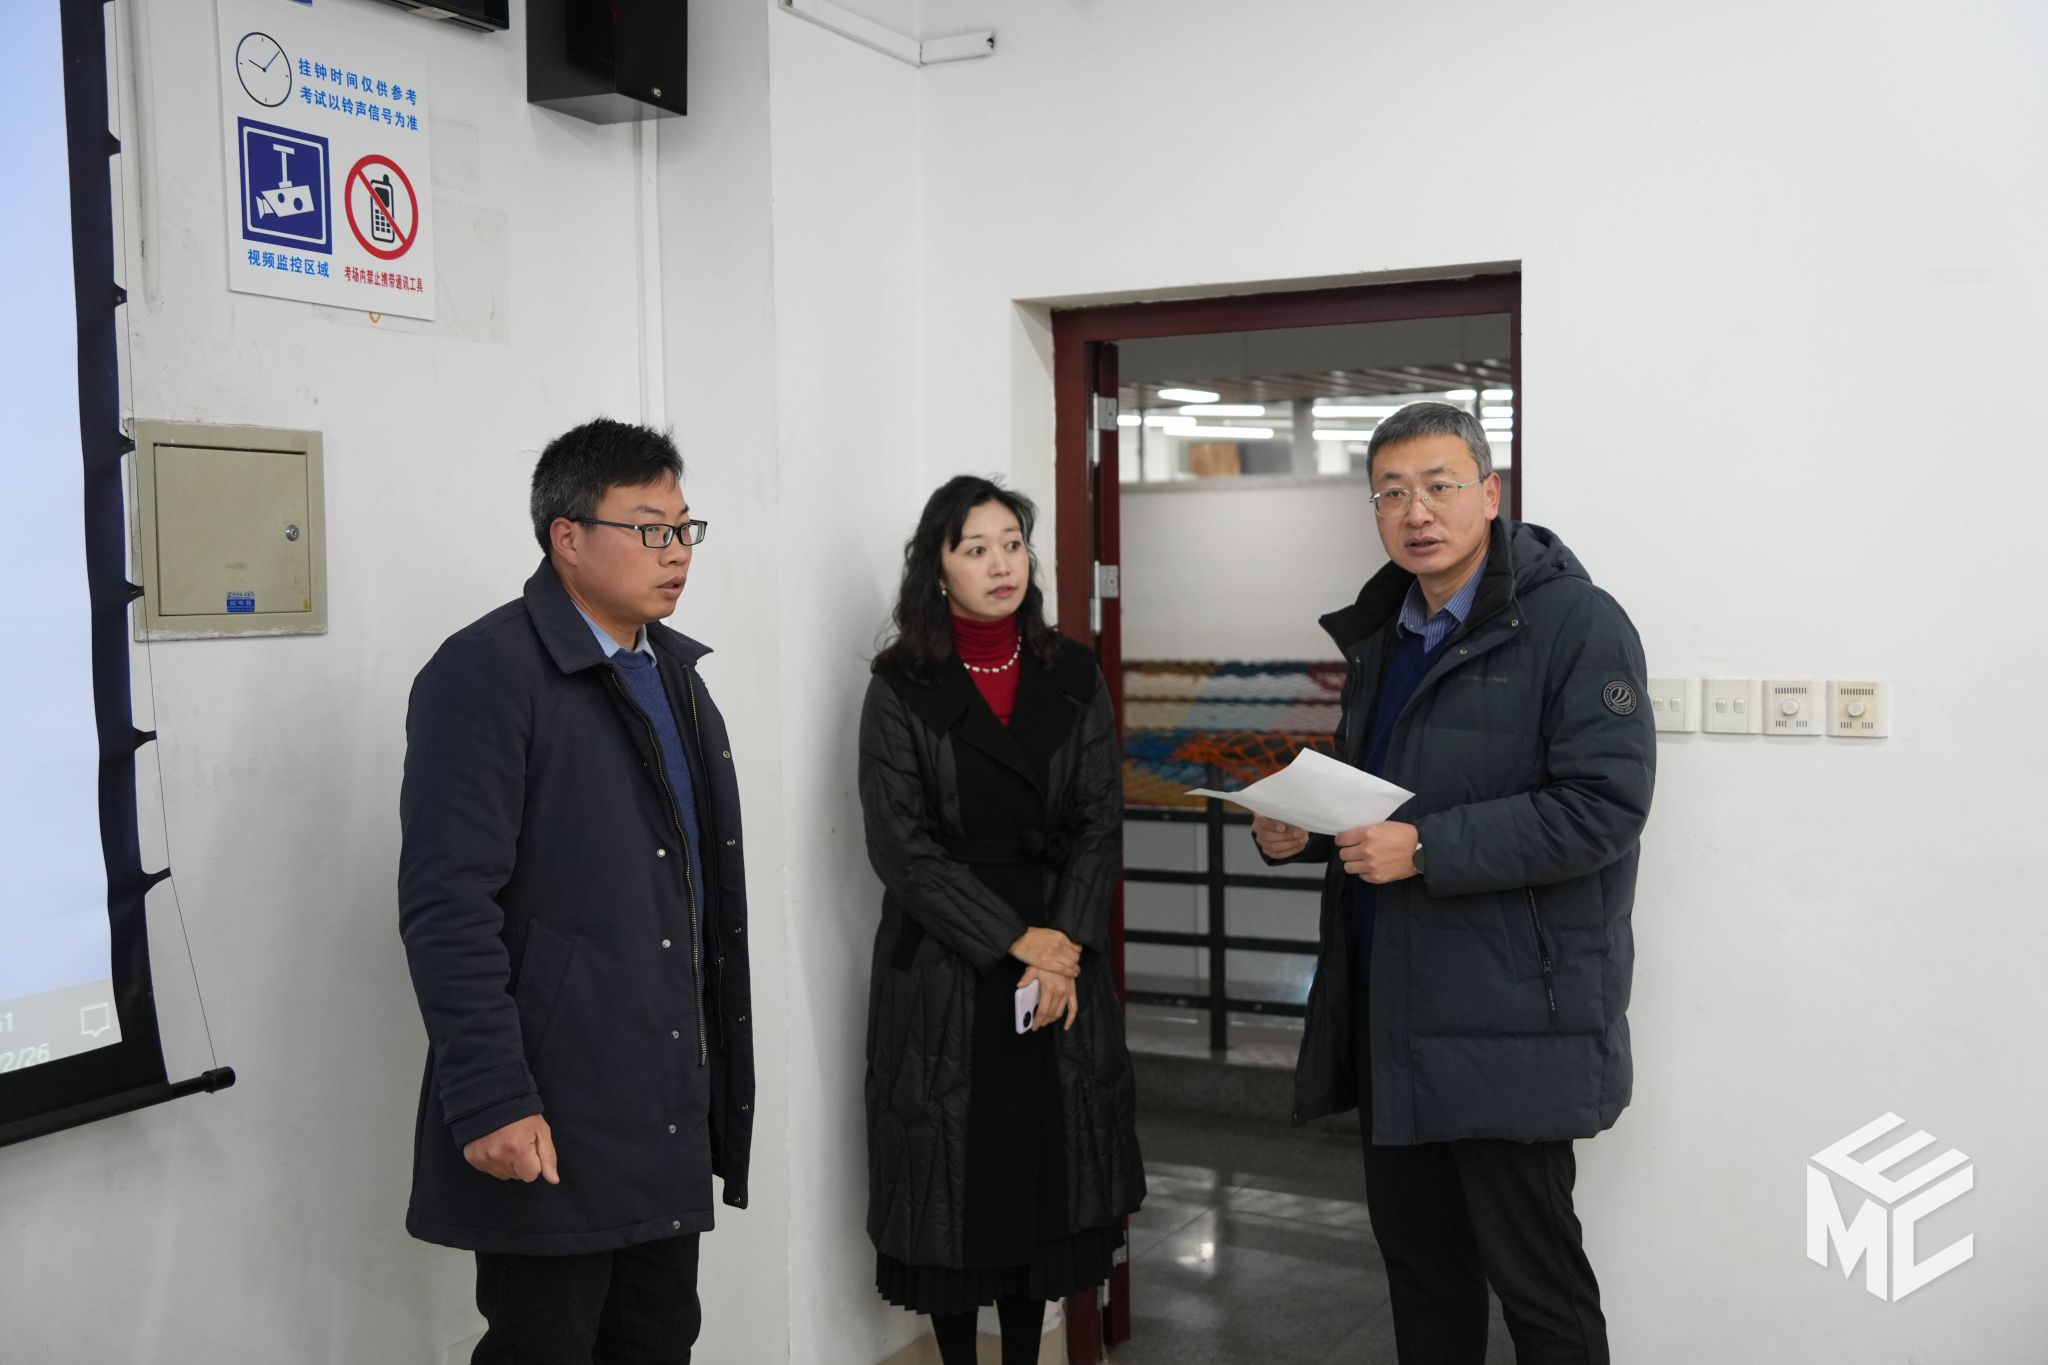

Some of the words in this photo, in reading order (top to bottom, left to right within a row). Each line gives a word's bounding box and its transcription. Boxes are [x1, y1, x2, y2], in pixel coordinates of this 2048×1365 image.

[298, 57, 418, 106] 挂钟时间仅供参考
[300, 86, 419, 131] 考试以铃声信号为准
[247, 248, 330, 278] 视频监控区域
[344, 264, 424, 293] 考场内禁止携带通讯工具
